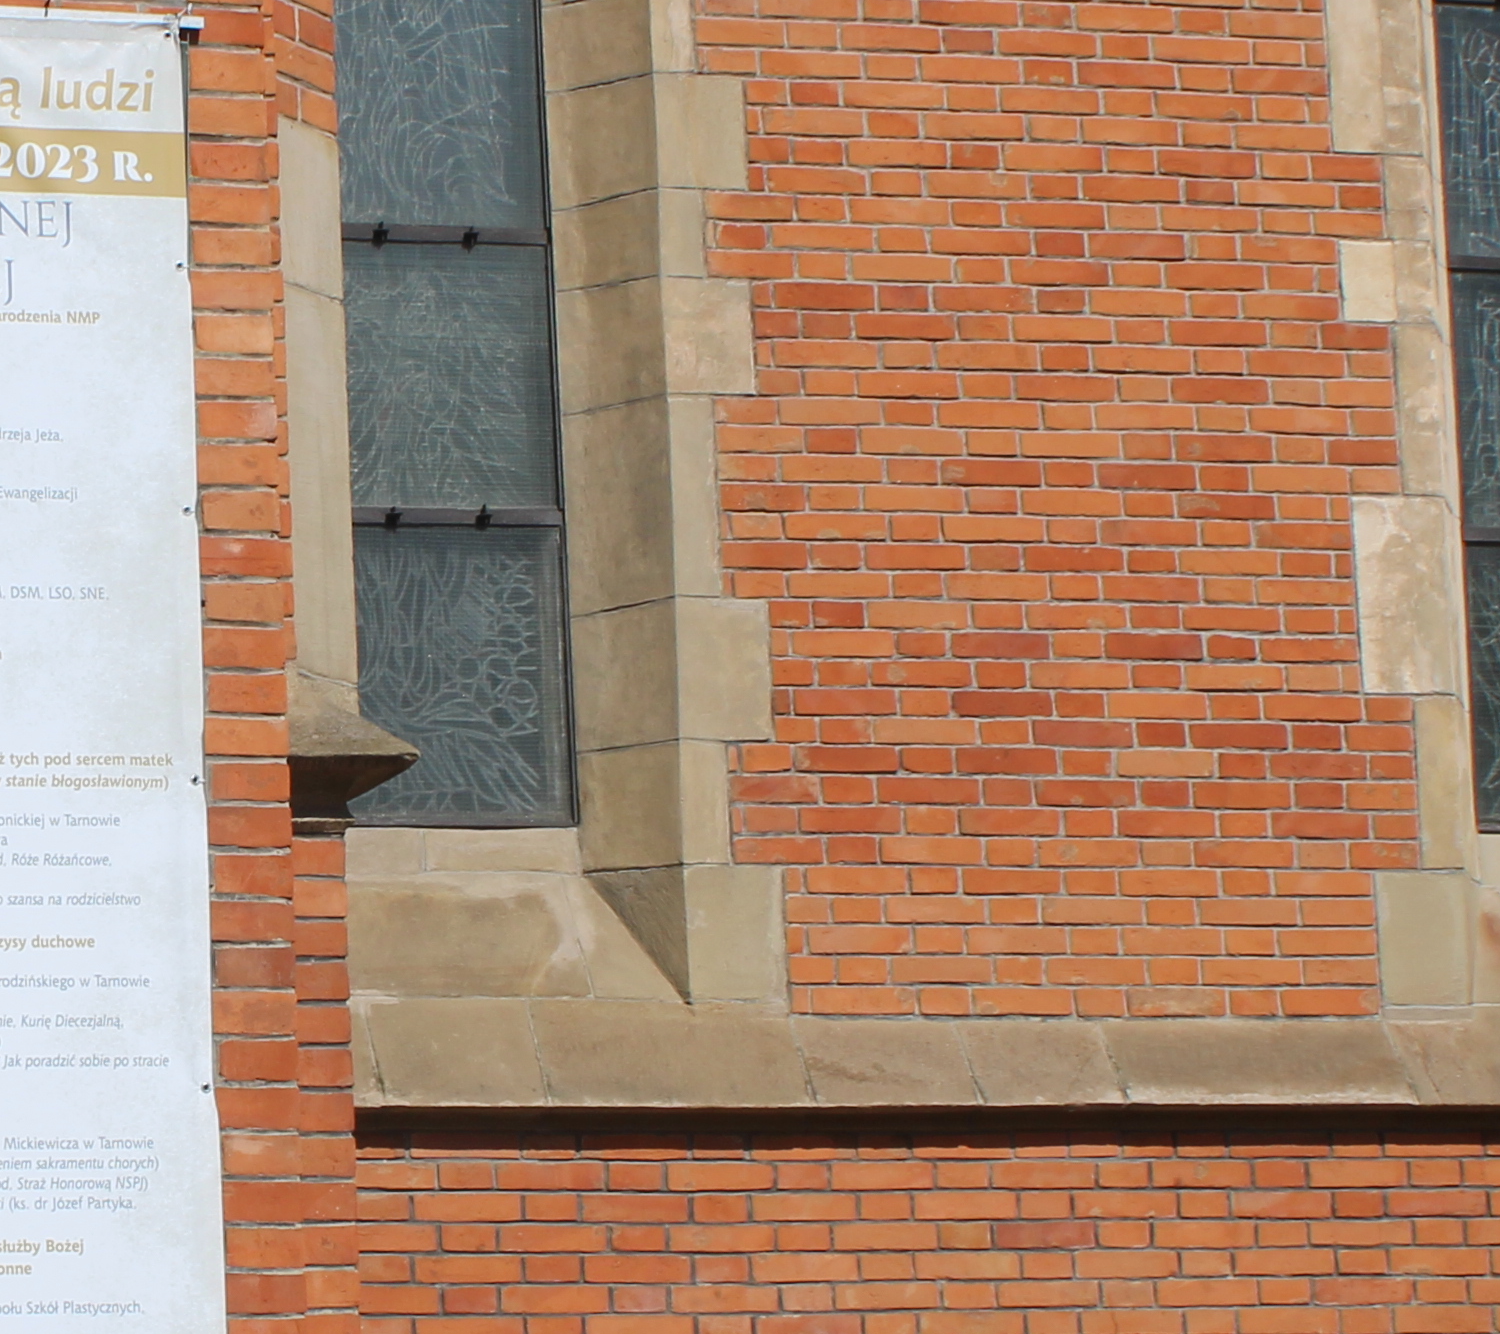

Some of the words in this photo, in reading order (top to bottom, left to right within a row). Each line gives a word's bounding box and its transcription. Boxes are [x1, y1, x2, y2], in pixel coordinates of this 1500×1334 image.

[39, 67, 154, 112] ludzi
[112, 150, 153, 181] R.
[65, 310, 101, 324] NMP
[30, 933, 95, 948] duchowe
[45, 1238, 84, 1256] Bożej
